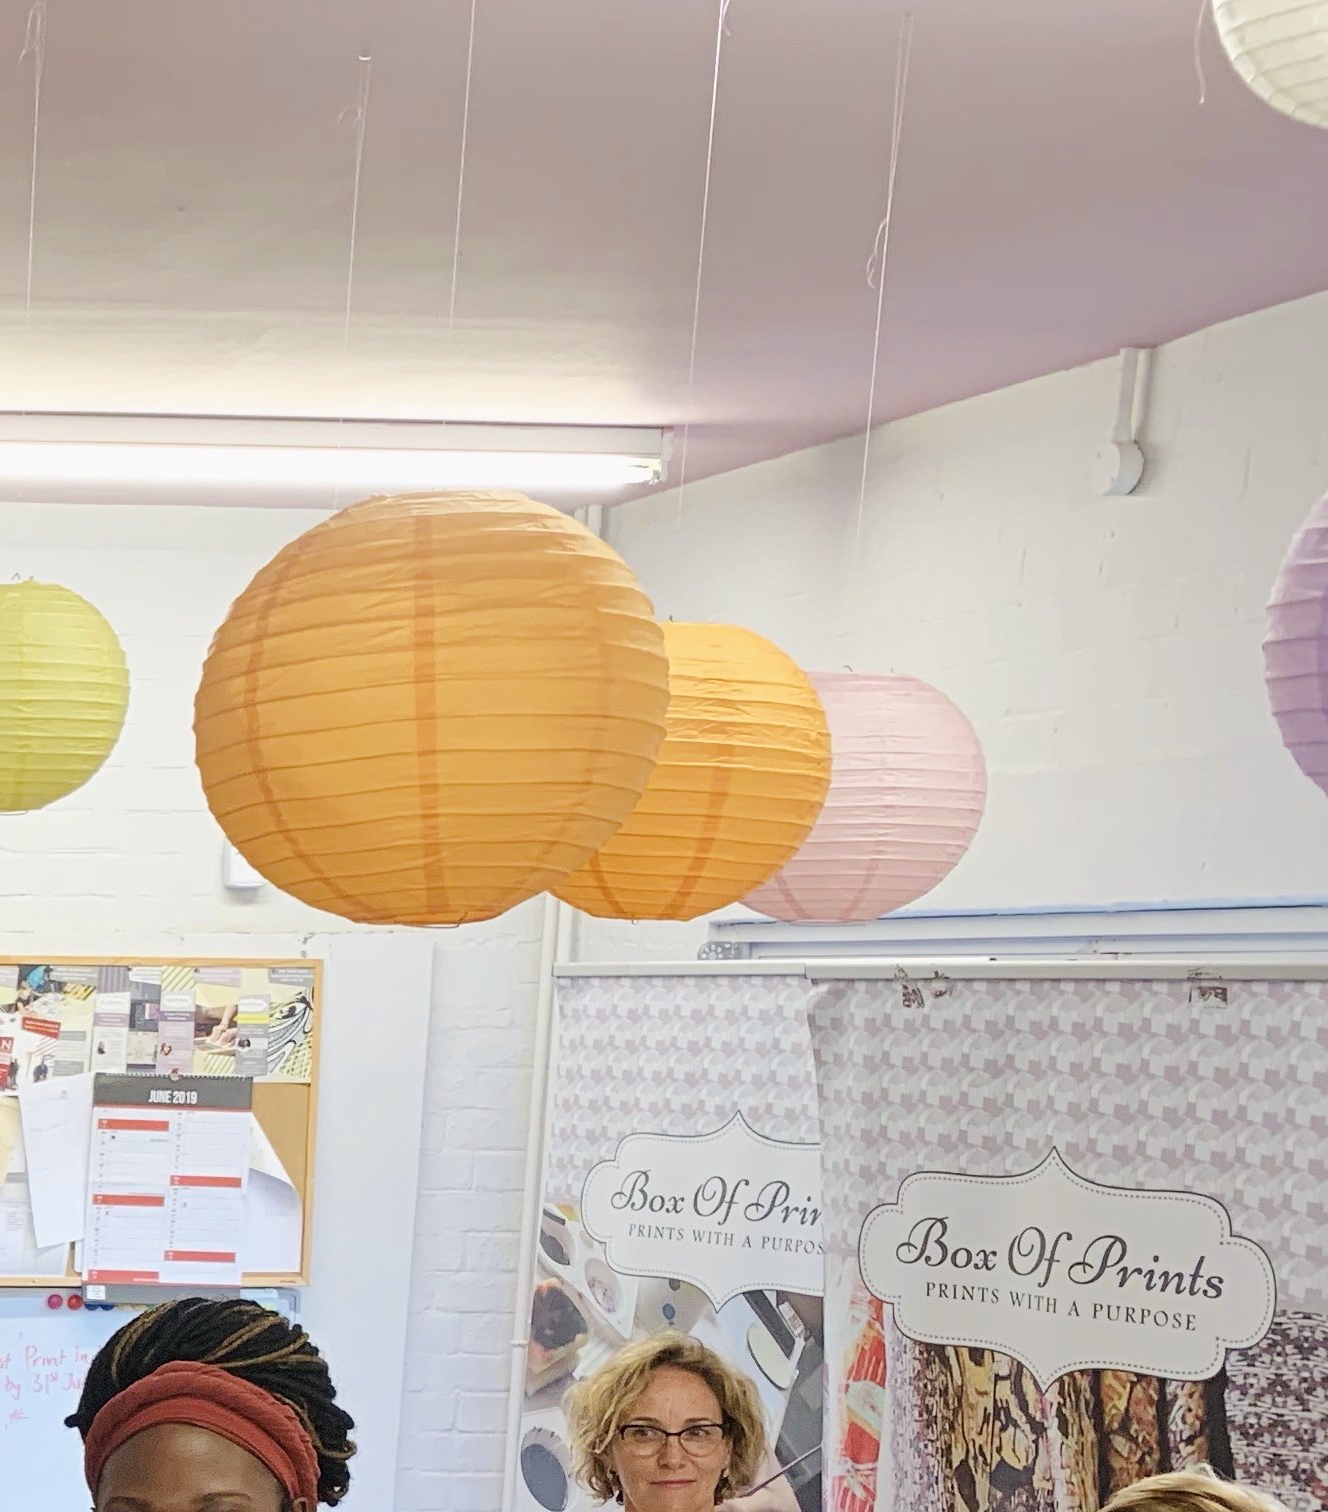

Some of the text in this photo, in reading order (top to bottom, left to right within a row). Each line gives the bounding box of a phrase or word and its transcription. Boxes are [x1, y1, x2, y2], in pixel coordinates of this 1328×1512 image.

[148, 1090, 198, 1104] JUNE 2019
[611, 1170, 685, 1214] Box
[693, 1175, 749, 1225] Of
[628, 1223, 827, 1255] PRINTS WITH A PURPOS
[896, 1217, 1225, 1299] Box Of Prints
[926, 1282, 1196, 1331] PRINTS WITH A PURPOSE
